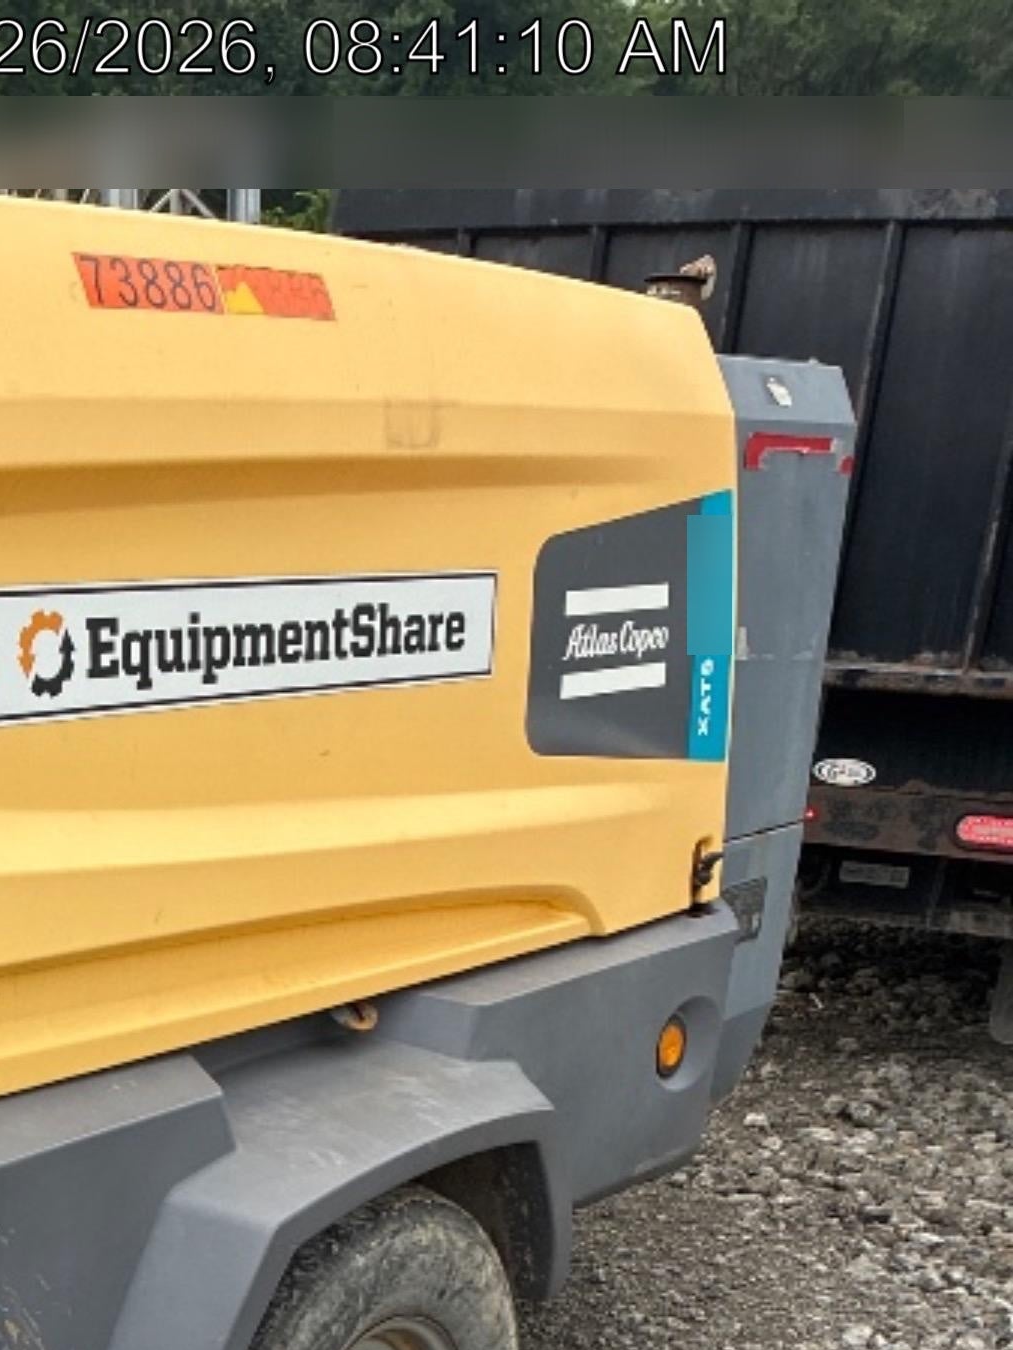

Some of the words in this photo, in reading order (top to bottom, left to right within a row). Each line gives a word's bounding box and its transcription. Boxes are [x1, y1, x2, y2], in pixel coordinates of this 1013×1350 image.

[80, 255, 216, 311] 73886
[86, 602, 465, 689] EquipmentShare
[562, 623, 618, 660] Atlas
[620, 620, 669, 658] Copco
